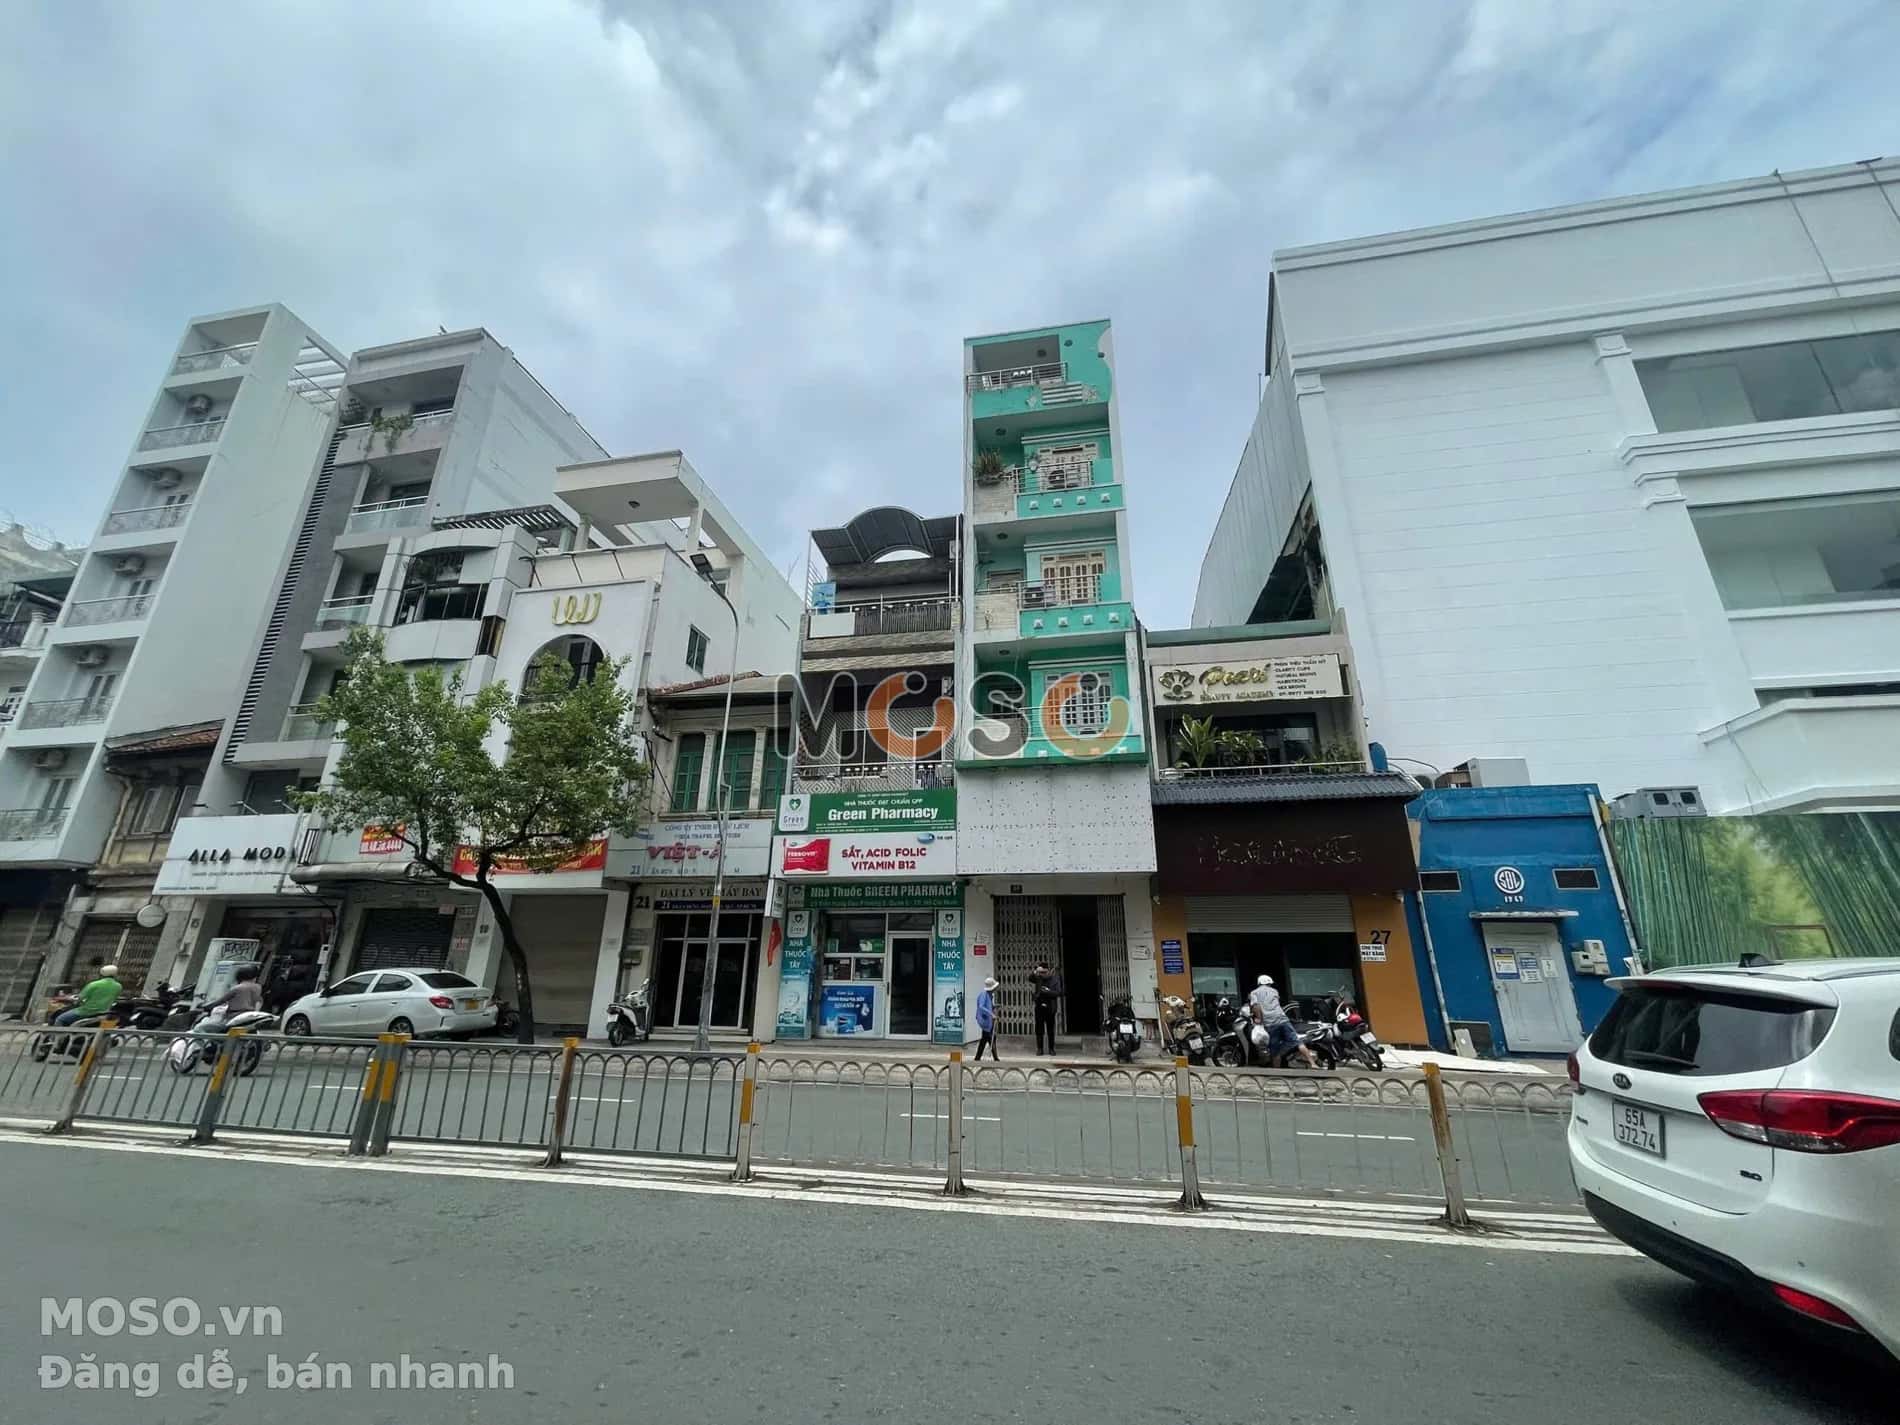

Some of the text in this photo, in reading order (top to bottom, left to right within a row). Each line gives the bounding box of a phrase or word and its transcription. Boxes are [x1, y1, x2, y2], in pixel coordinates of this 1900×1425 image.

[783, 815, 804, 823] Green
[828, 807, 938, 821] Green Pharmacy
[188, 848, 231, 863] ALLA
[842, 845, 927, 859] SẮT, ACID FOLIC
[851, 860, 916, 871] VITAMIN B12
[742, 887, 763, 897] BAY
[864, 886, 898, 897] GREEN
[900, 885, 957, 896] PHARMACY
[635, 896, 650, 909] 21
[1370, 929, 1392, 945] 27
[937, 951, 960, 959] THUỐC
[1626, 1108, 1646, 1129] 65A
[1619, 1124, 1655, 1149] 372.74
